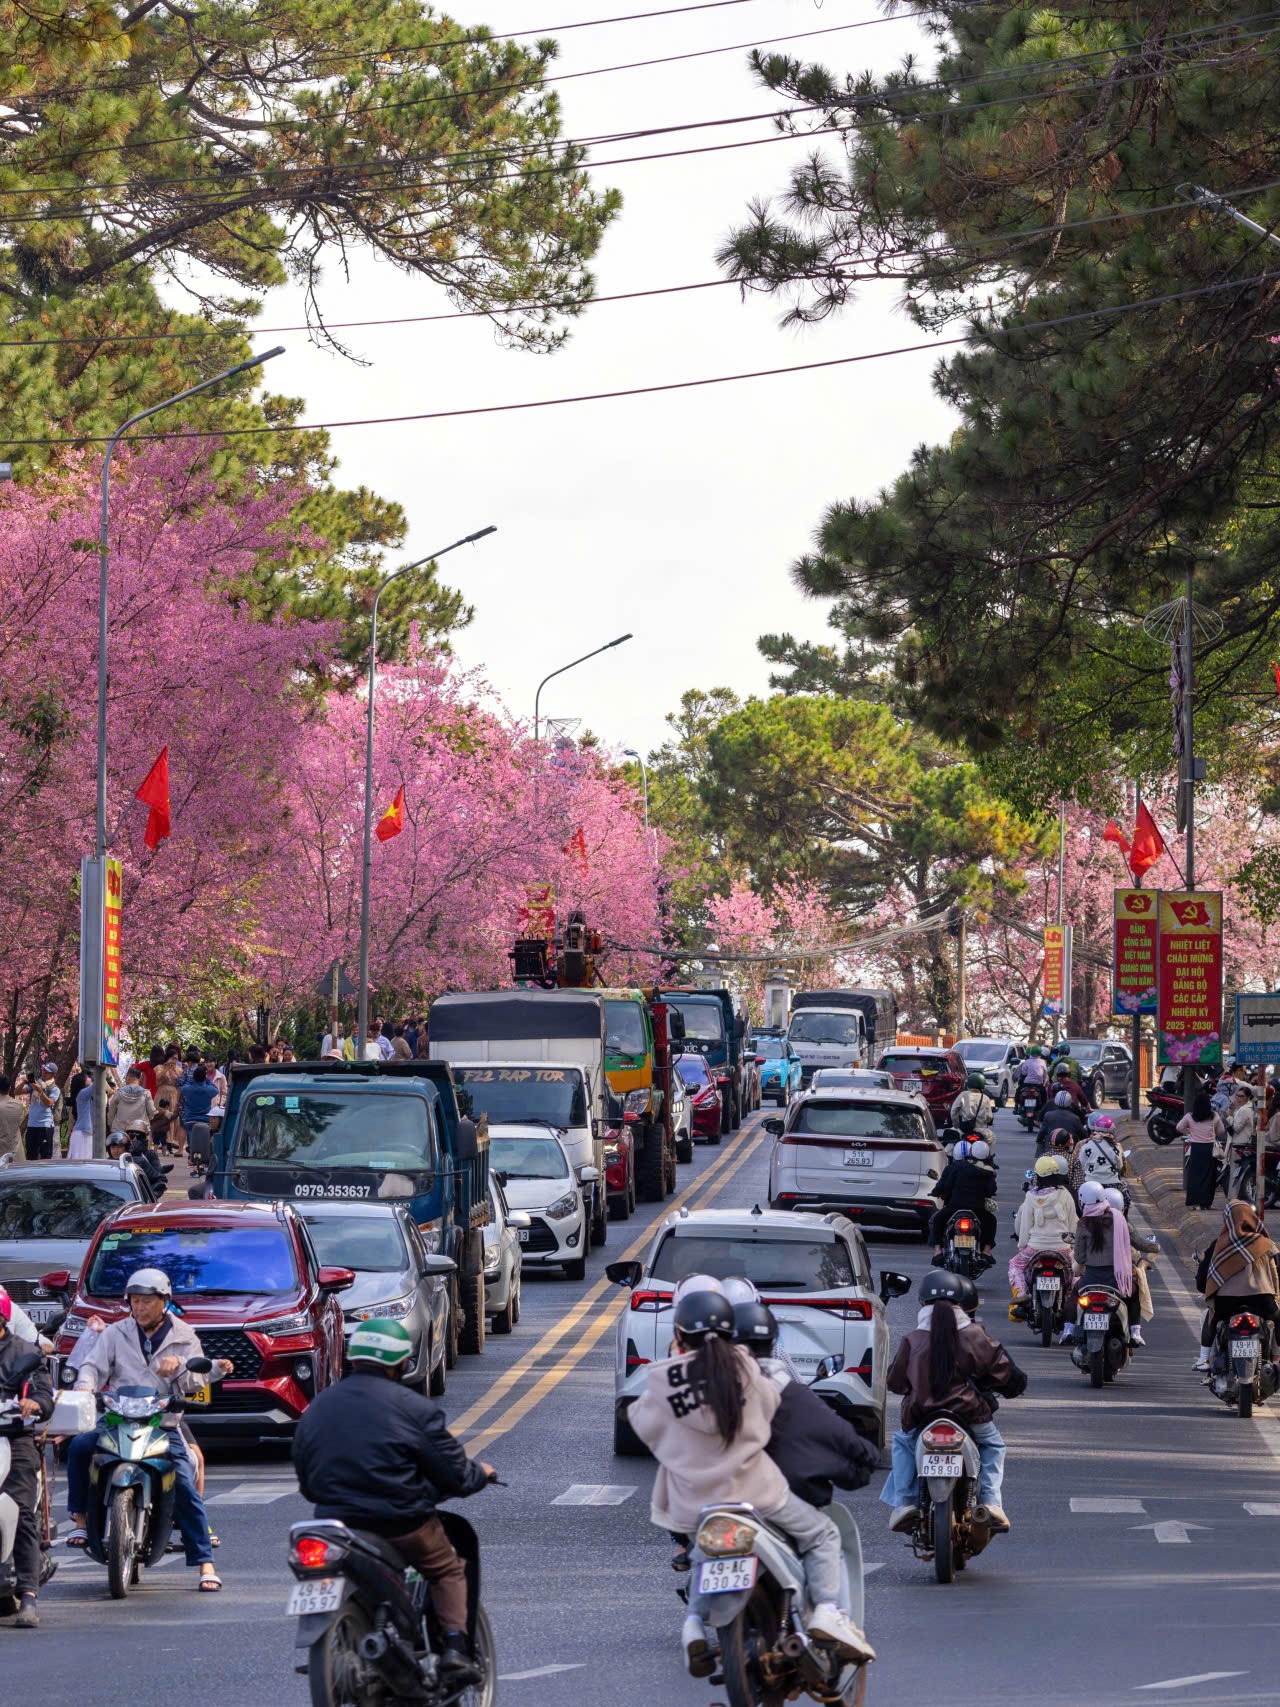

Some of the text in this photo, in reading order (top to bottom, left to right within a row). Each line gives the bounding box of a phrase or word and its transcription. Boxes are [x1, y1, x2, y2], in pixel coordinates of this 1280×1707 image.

[1170, 939, 1211, 951] NHIỆT LIỆT
[1137, 951, 1151, 960] NAM
[1191, 967, 1205, 979] HỘI
[1196, 979, 1208, 992] BỘ
[1173, 993, 1189, 1003] CÁC
[1171, 1006, 1197, 1018] NHIỆM
[1165, 1021, 1185, 1030] 2025
[463, 1070, 496, 1082] F22
[294, 1185, 370, 1198] 0979.353637
[928, 1455, 956, 1465] 49-AC
[923, 1465, 960, 1475] 058.90
[709, 1560, 747, 1575] 49-AC
